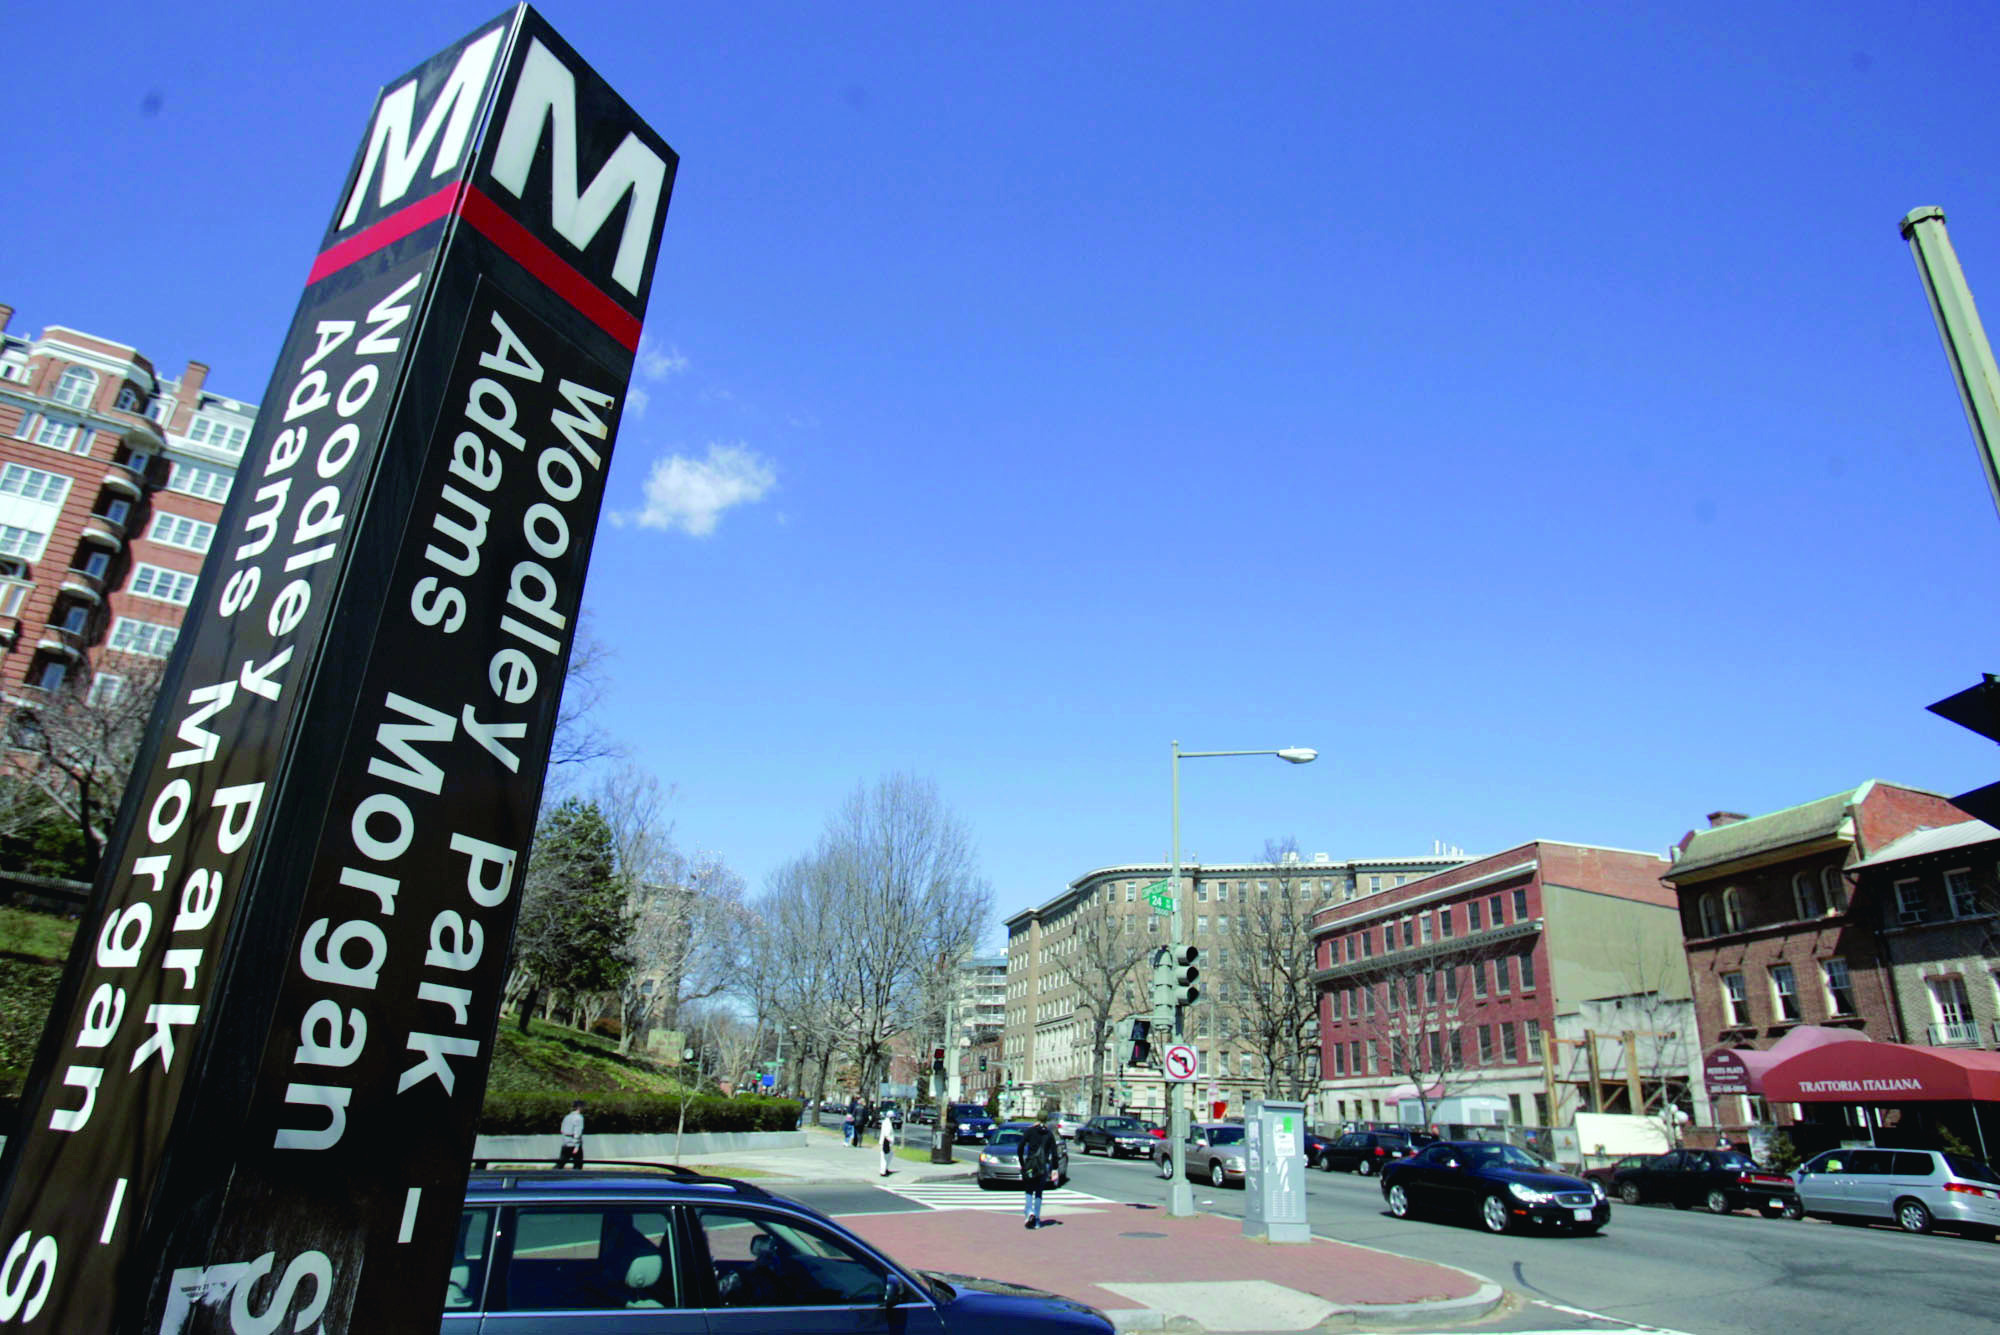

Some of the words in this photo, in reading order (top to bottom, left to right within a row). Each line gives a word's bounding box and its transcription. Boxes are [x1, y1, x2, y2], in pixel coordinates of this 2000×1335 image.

[339, 25, 504, 230] M
[491, 38, 665, 296] M
[219, 320, 356, 617] Adams
[240, 272, 422, 701] Woodley
[411, 311, 543, 632] Adams
[463, 378, 615, 773] Woodley
[50, 680, 238, 1132] Morgan
[130, 782, 265, 1073] Park
[274, 692, 457, 1150] Morgan
[398, 833, 516, 1096] Park
[1798, 1080, 1862, 1093] TRATTORIA
[1862, 1078, 1922, 1091] ITALIANA
